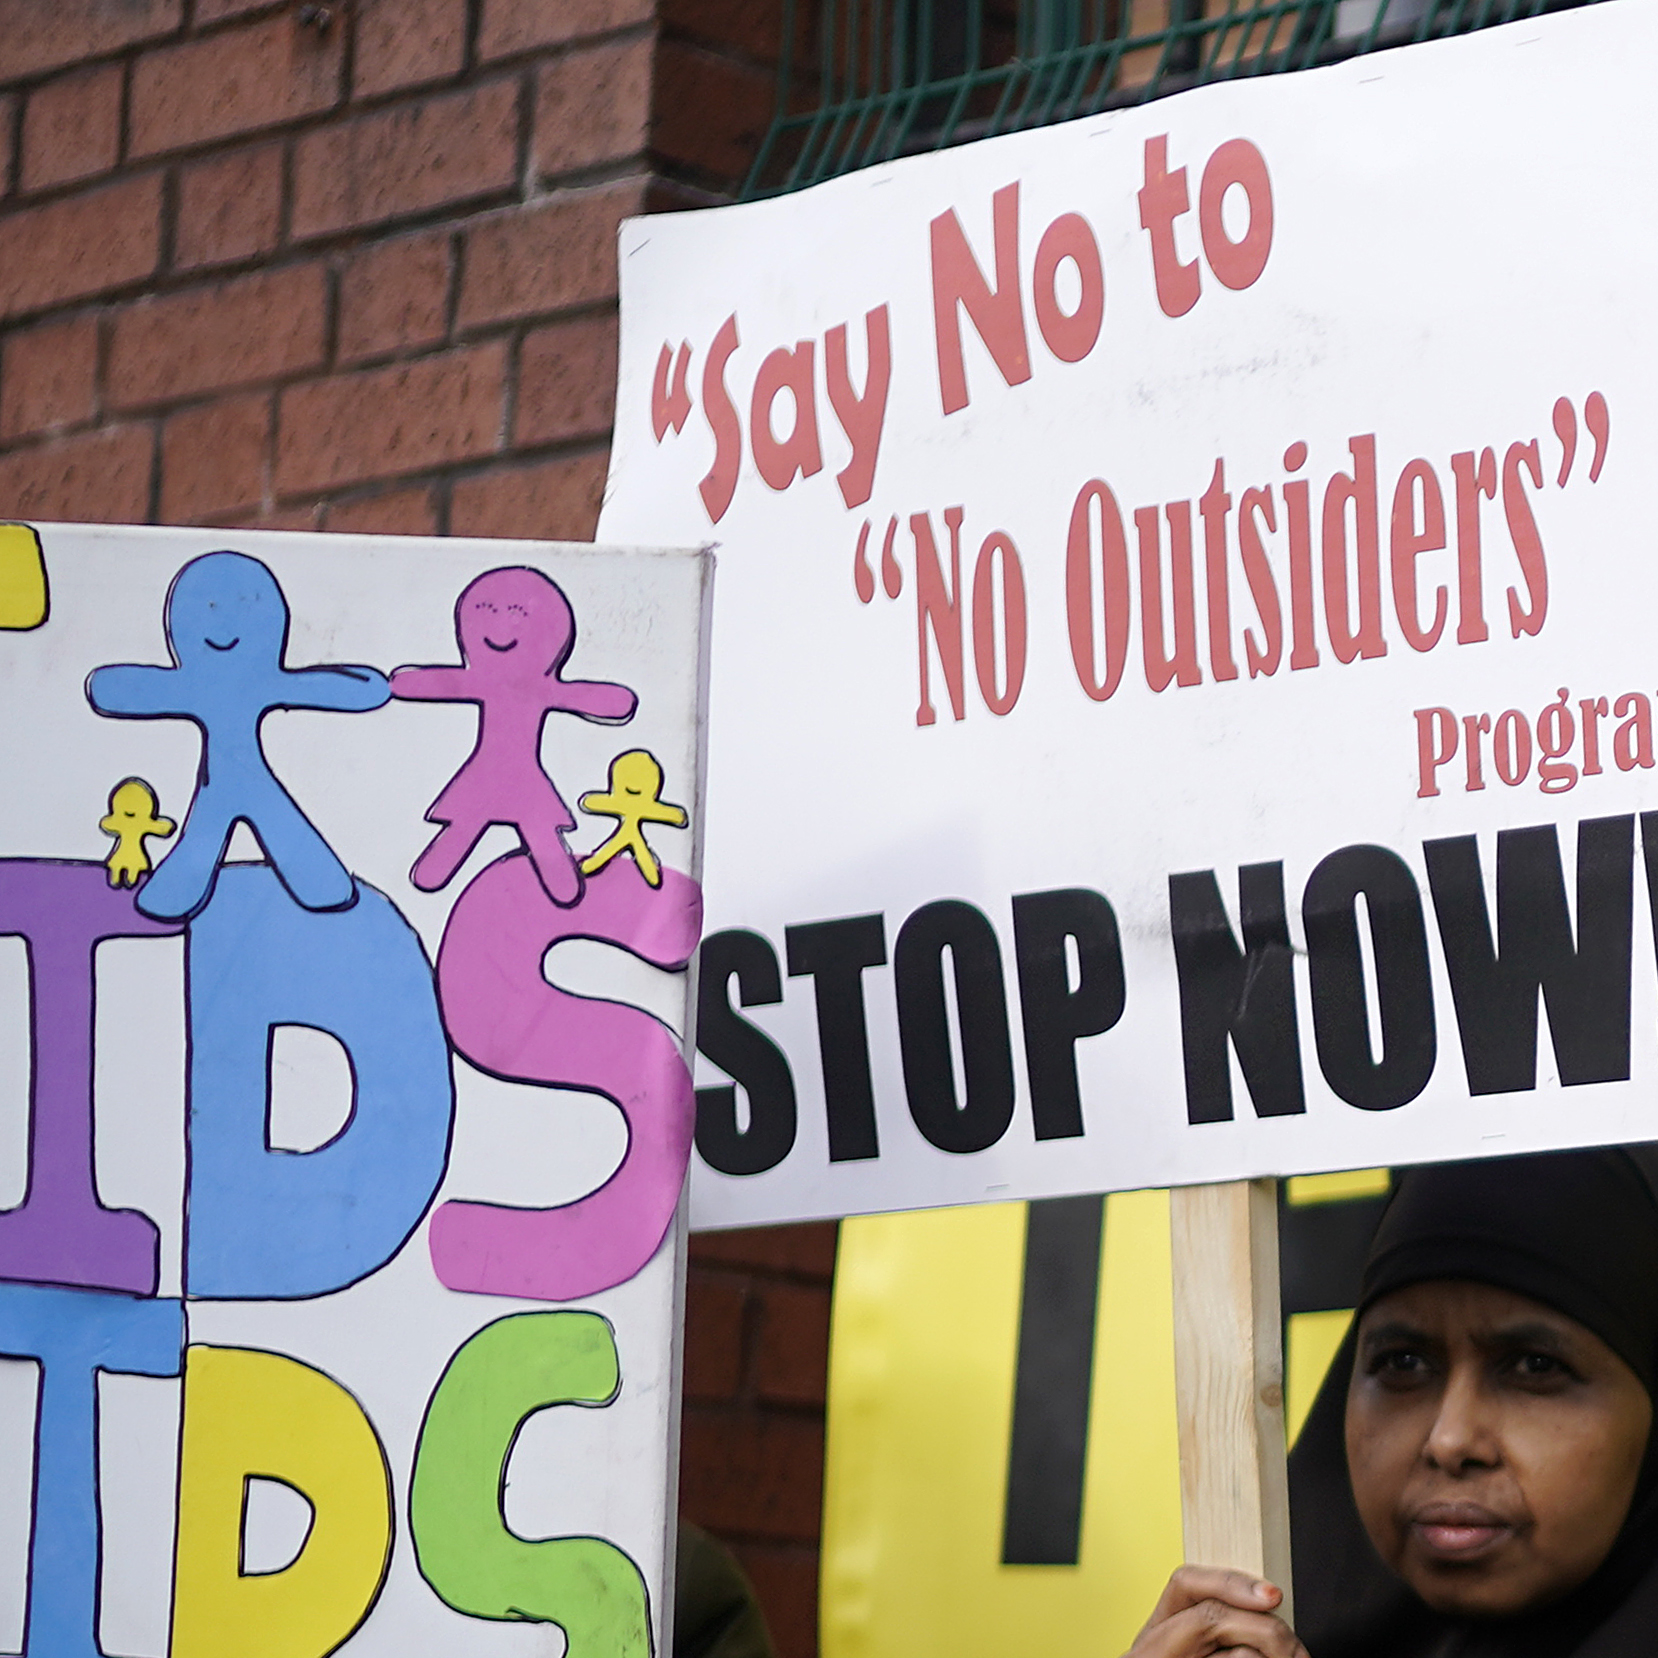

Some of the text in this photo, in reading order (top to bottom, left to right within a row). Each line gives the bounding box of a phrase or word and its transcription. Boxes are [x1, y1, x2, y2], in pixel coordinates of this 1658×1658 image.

[929, 180, 1105, 416] No
[1136, 133, 1275, 319] to
[694, 887, 1127, 1178] STOP
